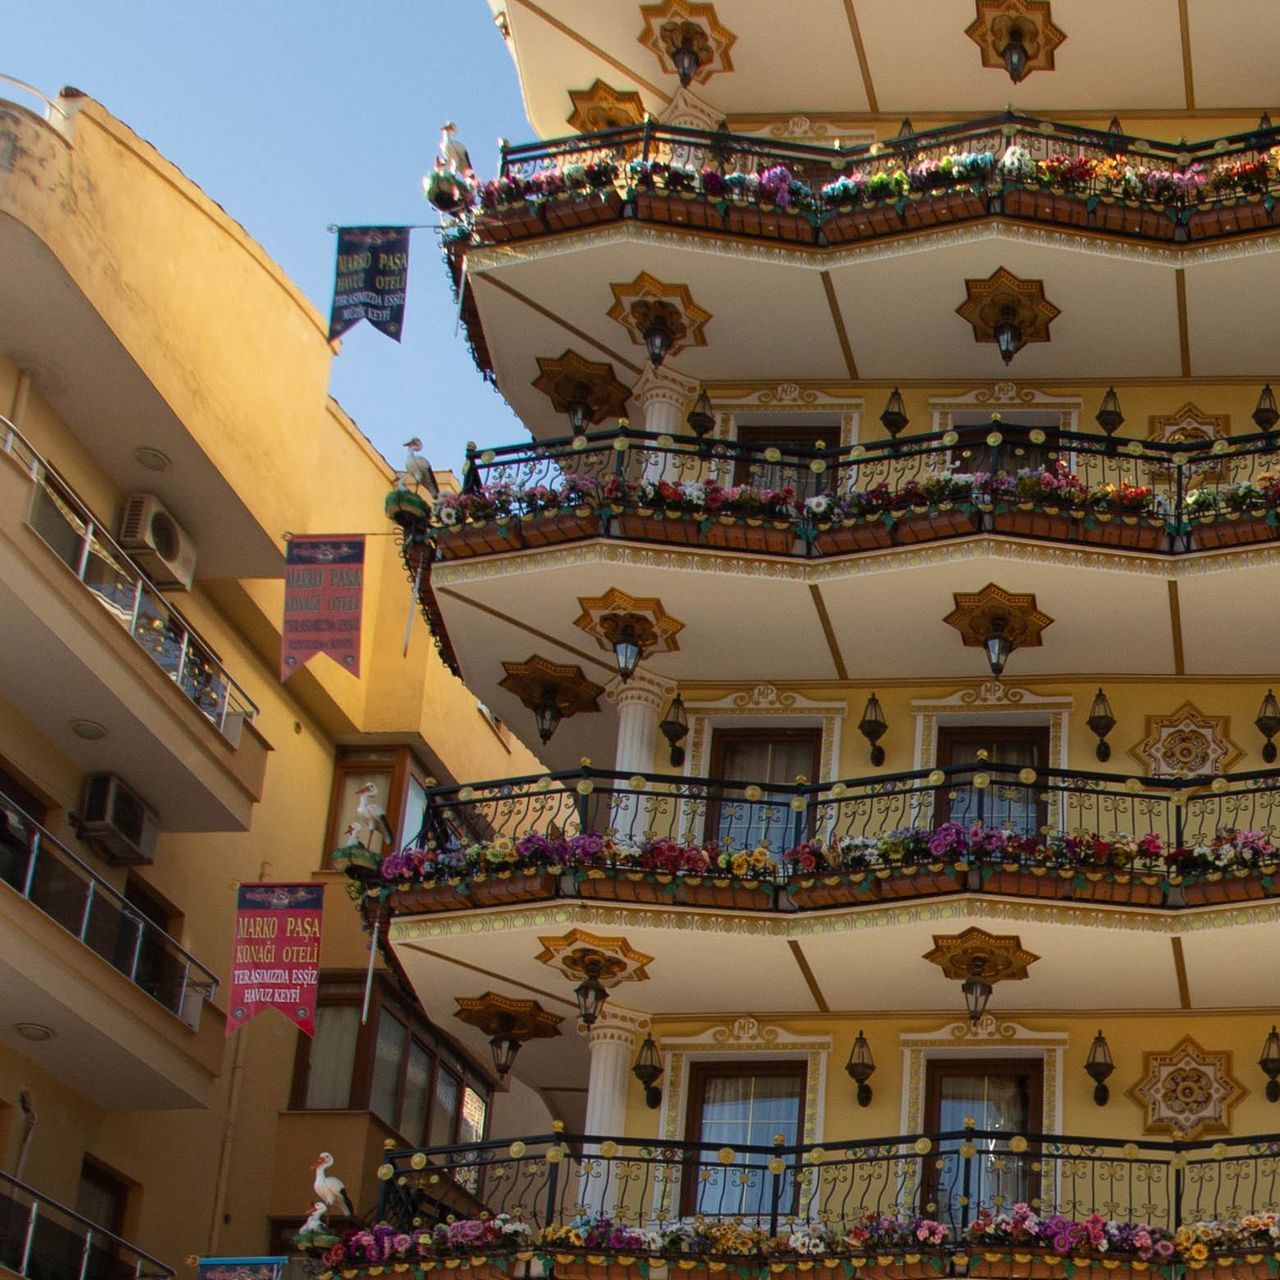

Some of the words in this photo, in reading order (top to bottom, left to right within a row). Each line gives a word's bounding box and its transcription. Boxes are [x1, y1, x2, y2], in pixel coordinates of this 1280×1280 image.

[237, 917, 278, 939] MARKO
[286, 917, 320, 943] PAŞA
[236, 941, 275, 963] KONAĞI
[282, 943, 319, 962] OTELİ
[234, 969, 289, 984] TERASIMIZDA
[244, 988, 273, 1003] HAVUZ
[273, 986, 300, 1003] KEYFİ
